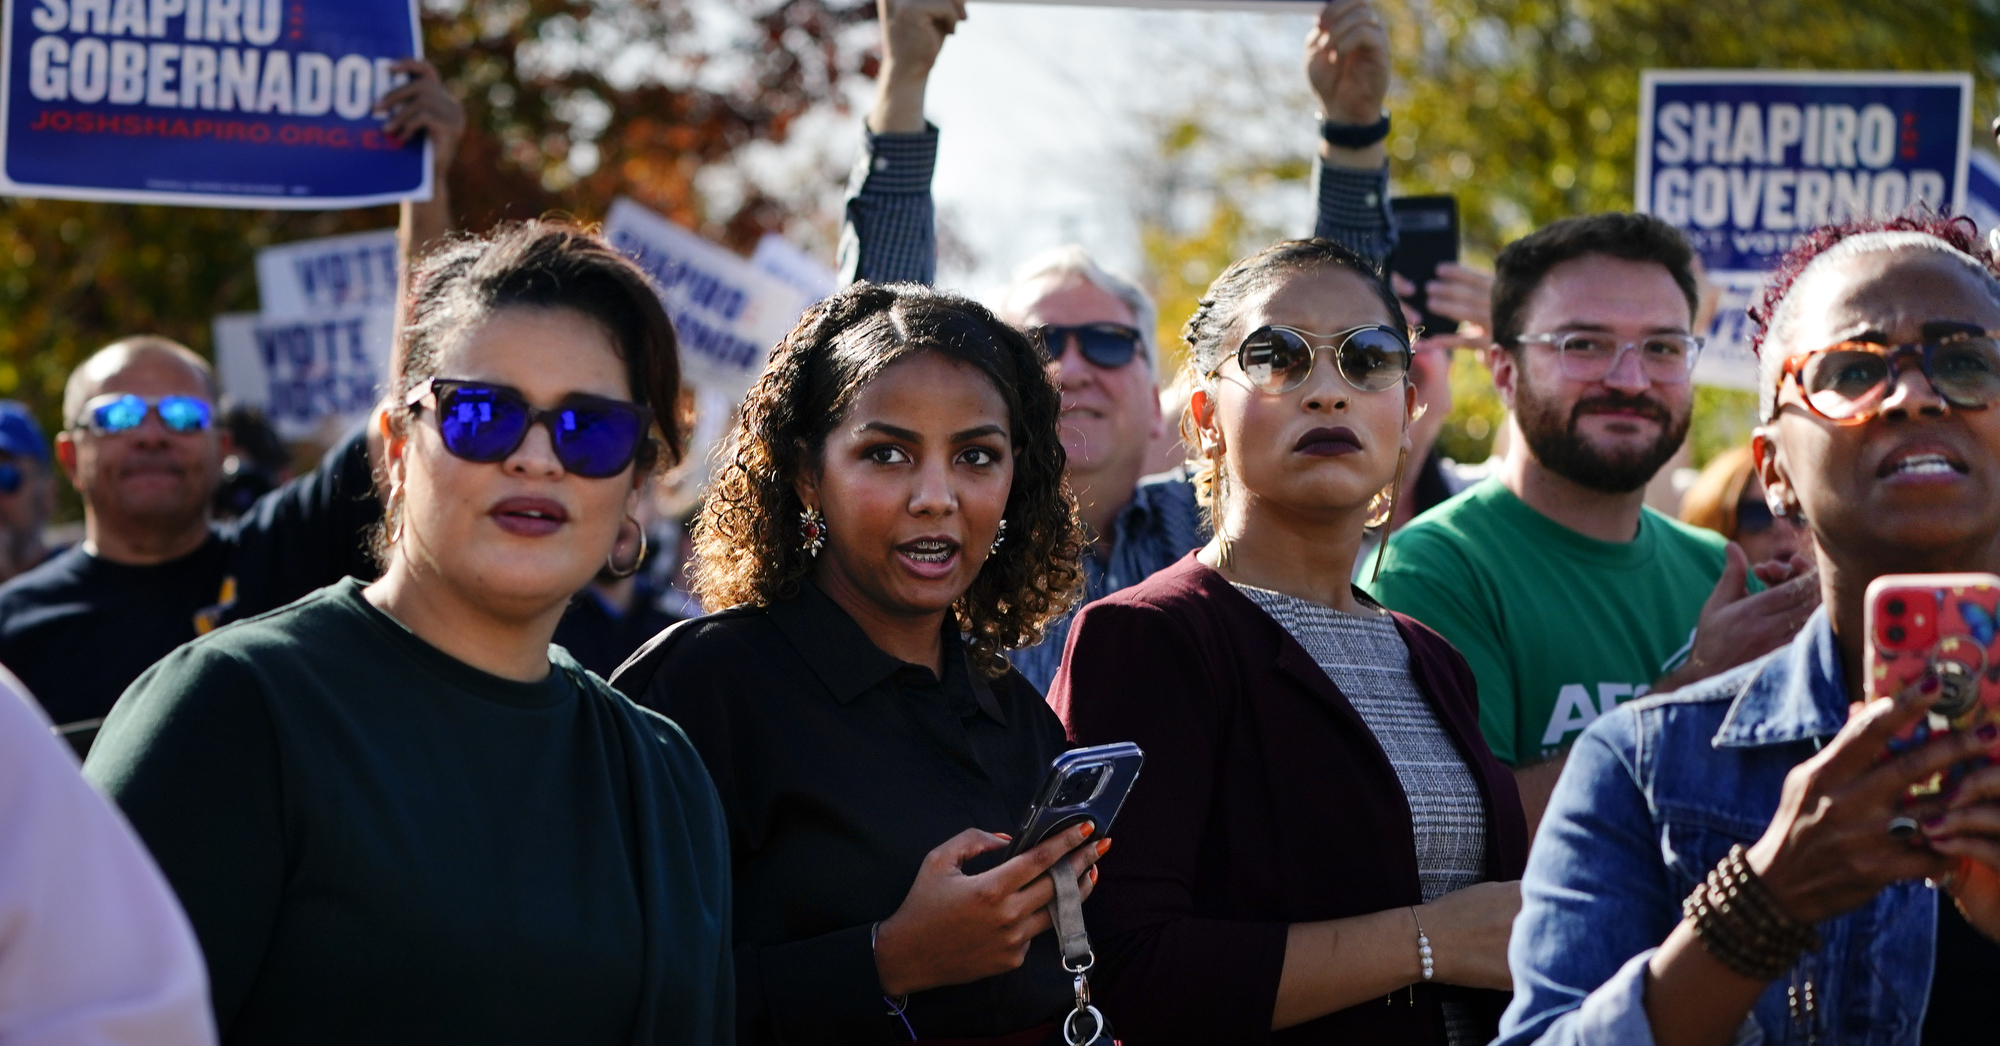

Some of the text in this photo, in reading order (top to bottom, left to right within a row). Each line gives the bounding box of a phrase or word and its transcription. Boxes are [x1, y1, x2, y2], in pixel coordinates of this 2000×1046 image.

[1655, 102, 1897, 168] SHAPIRO
[1654, 167, 1946, 230] GOVERNOR
[254, 317, 365, 370] VOTE
